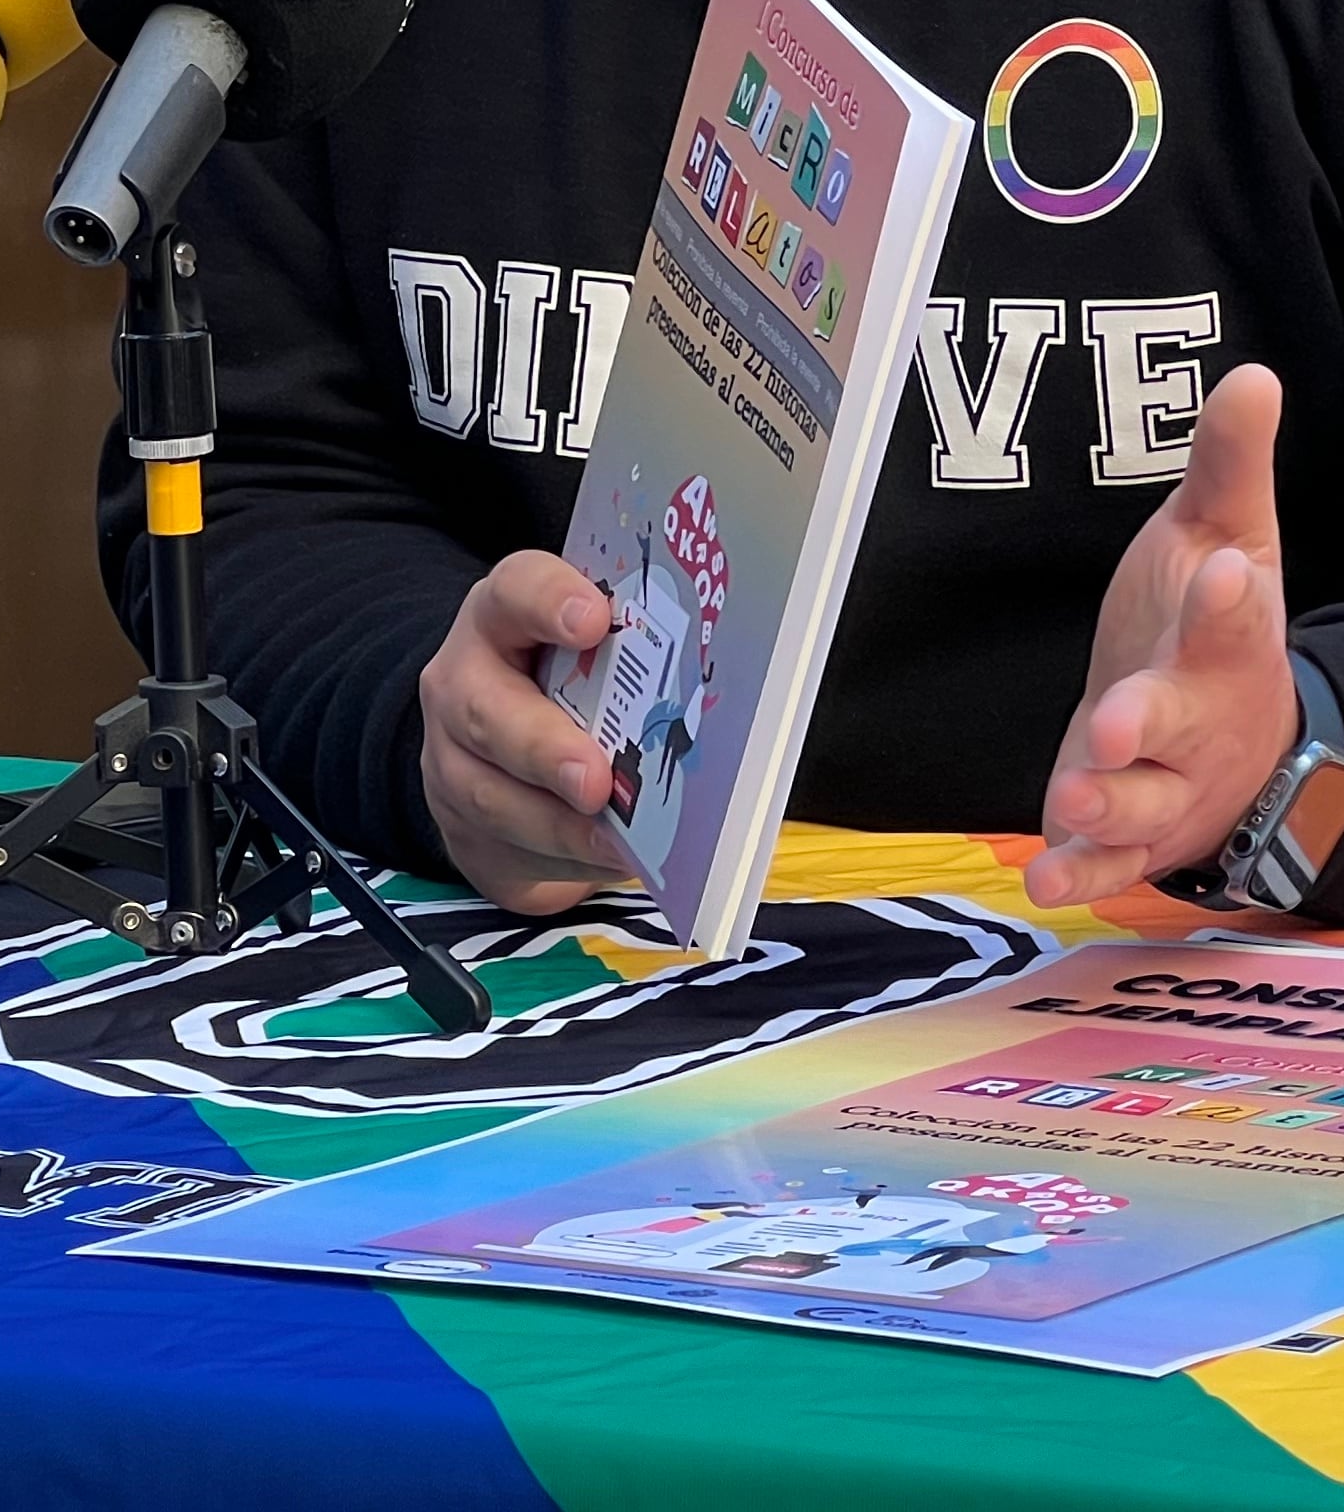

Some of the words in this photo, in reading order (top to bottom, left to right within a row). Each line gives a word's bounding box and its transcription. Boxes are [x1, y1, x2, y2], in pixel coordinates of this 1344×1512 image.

[765, 8, 839, 108] Concurso
[838, 81, 862, 132] de
[702, 300, 721, 338] de
[721, 315, 744, 360] las
[743, 342, 764, 382] 22
[645, 294, 718, 389] presentadas
[717, 373, 737, 406] al
[734, 391, 796, 473] certamen
[834, 1119, 1092, 1153] presentadas
[1096, 1147, 1147, 1158] al
[839, 1104, 1038, 1133] Colección
[1045, 1128, 1100, 1140] de
[1106, 1132, 1169, 1146] las
[1172, 1139, 1236, 1153] 22
